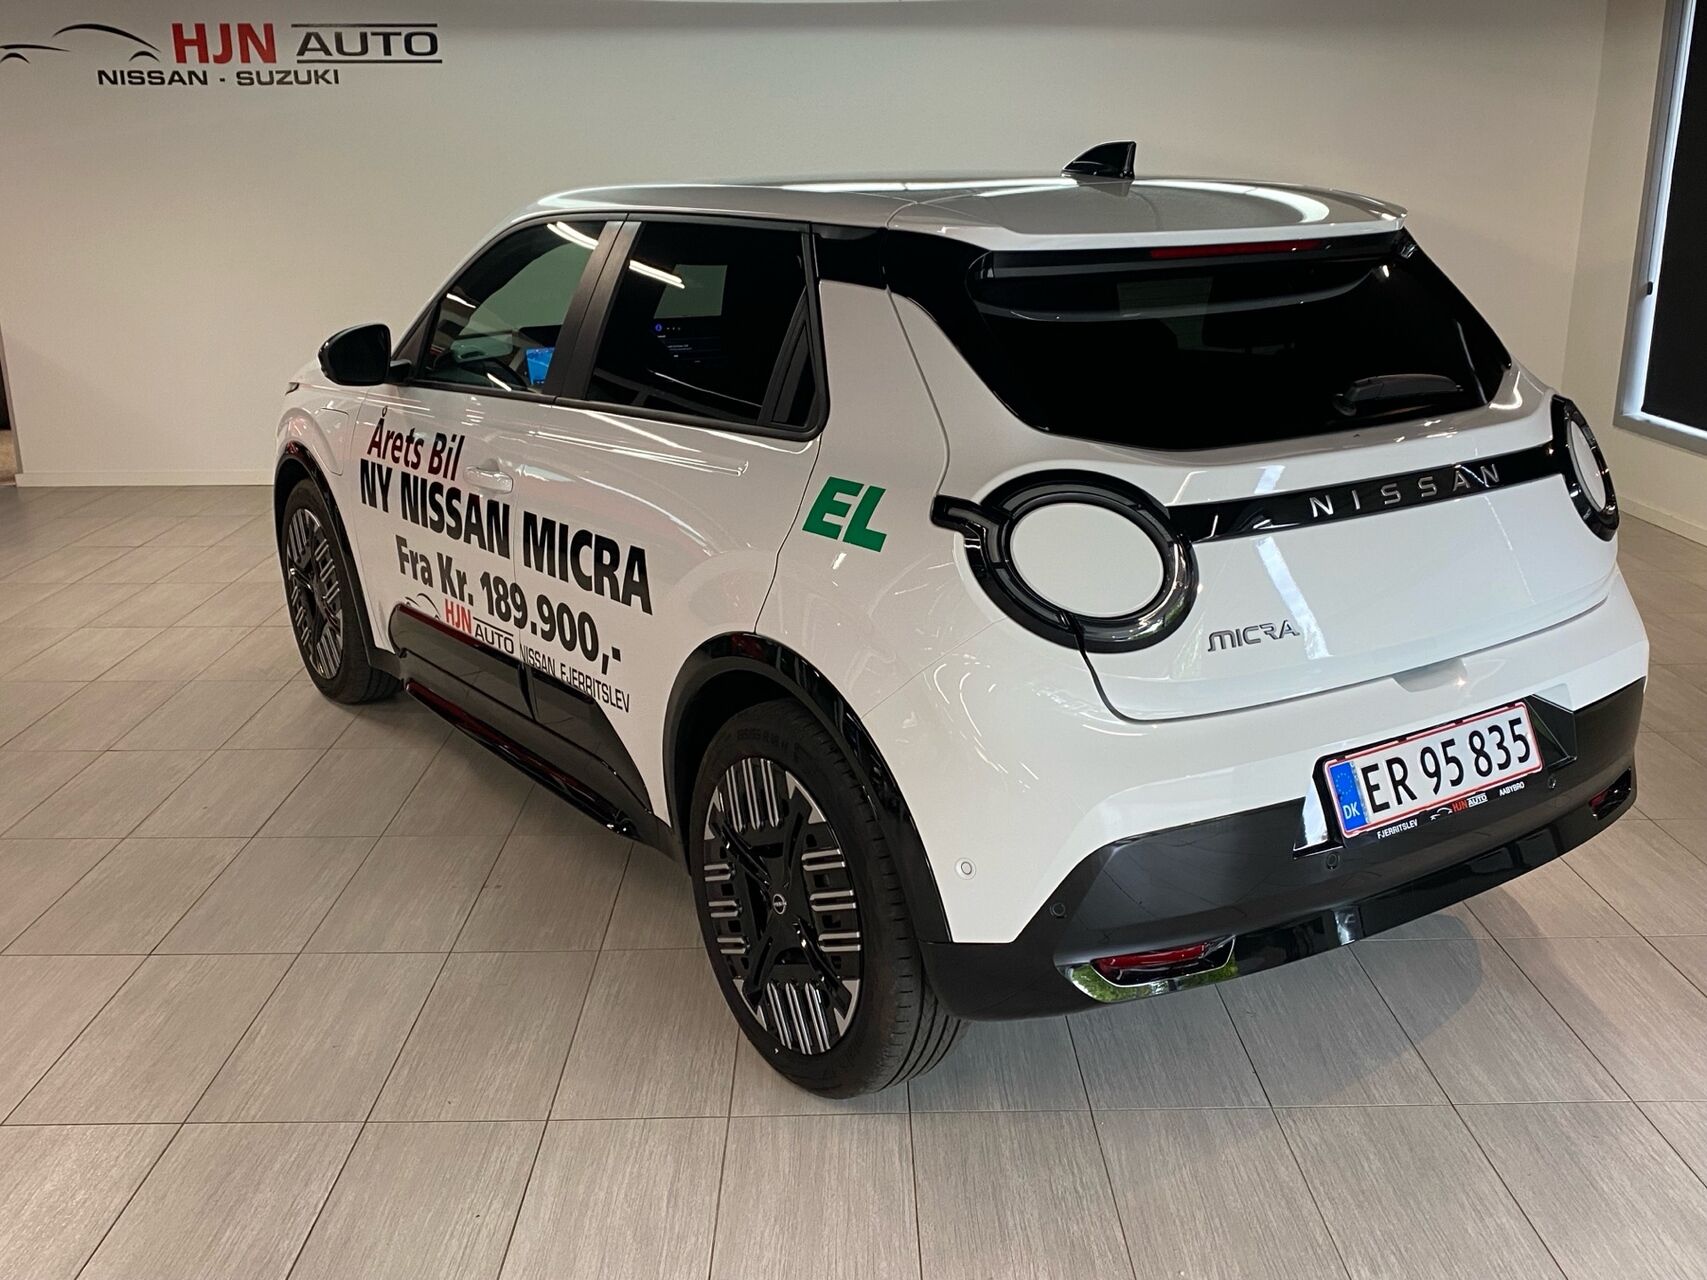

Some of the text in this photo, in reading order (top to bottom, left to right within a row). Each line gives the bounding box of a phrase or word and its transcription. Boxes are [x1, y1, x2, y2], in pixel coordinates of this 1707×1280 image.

[171, 23, 438, 64] HJN AUTO
[97, 70, 208, 86] NISSAN
[236, 69, 340, 86] SUZUKI
[367, 405, 466, 482] Årets Bil
[802, 476, 887, 553] EL
[1308, 463, 1501, 518] NISSAN
[360, 458, 653, 616] NY NISSAN MICRA
[395, 534, 622, 676] Fra Kr. 189.900,-
[1208, 619, 1300, 652] MICRA
[444, 598, 630, 713] HJN AUTO NISSAN FJERRITSLEV
[1361, 717, 1531, 814] ER 95 835
[1343, 802, 1361, 820] DK
[1377, 818, 1418, 839] FJERRITSLEV
[1452, 799, 1468, 812] HJN
[1468, 793, 1488, 807] AUTO
